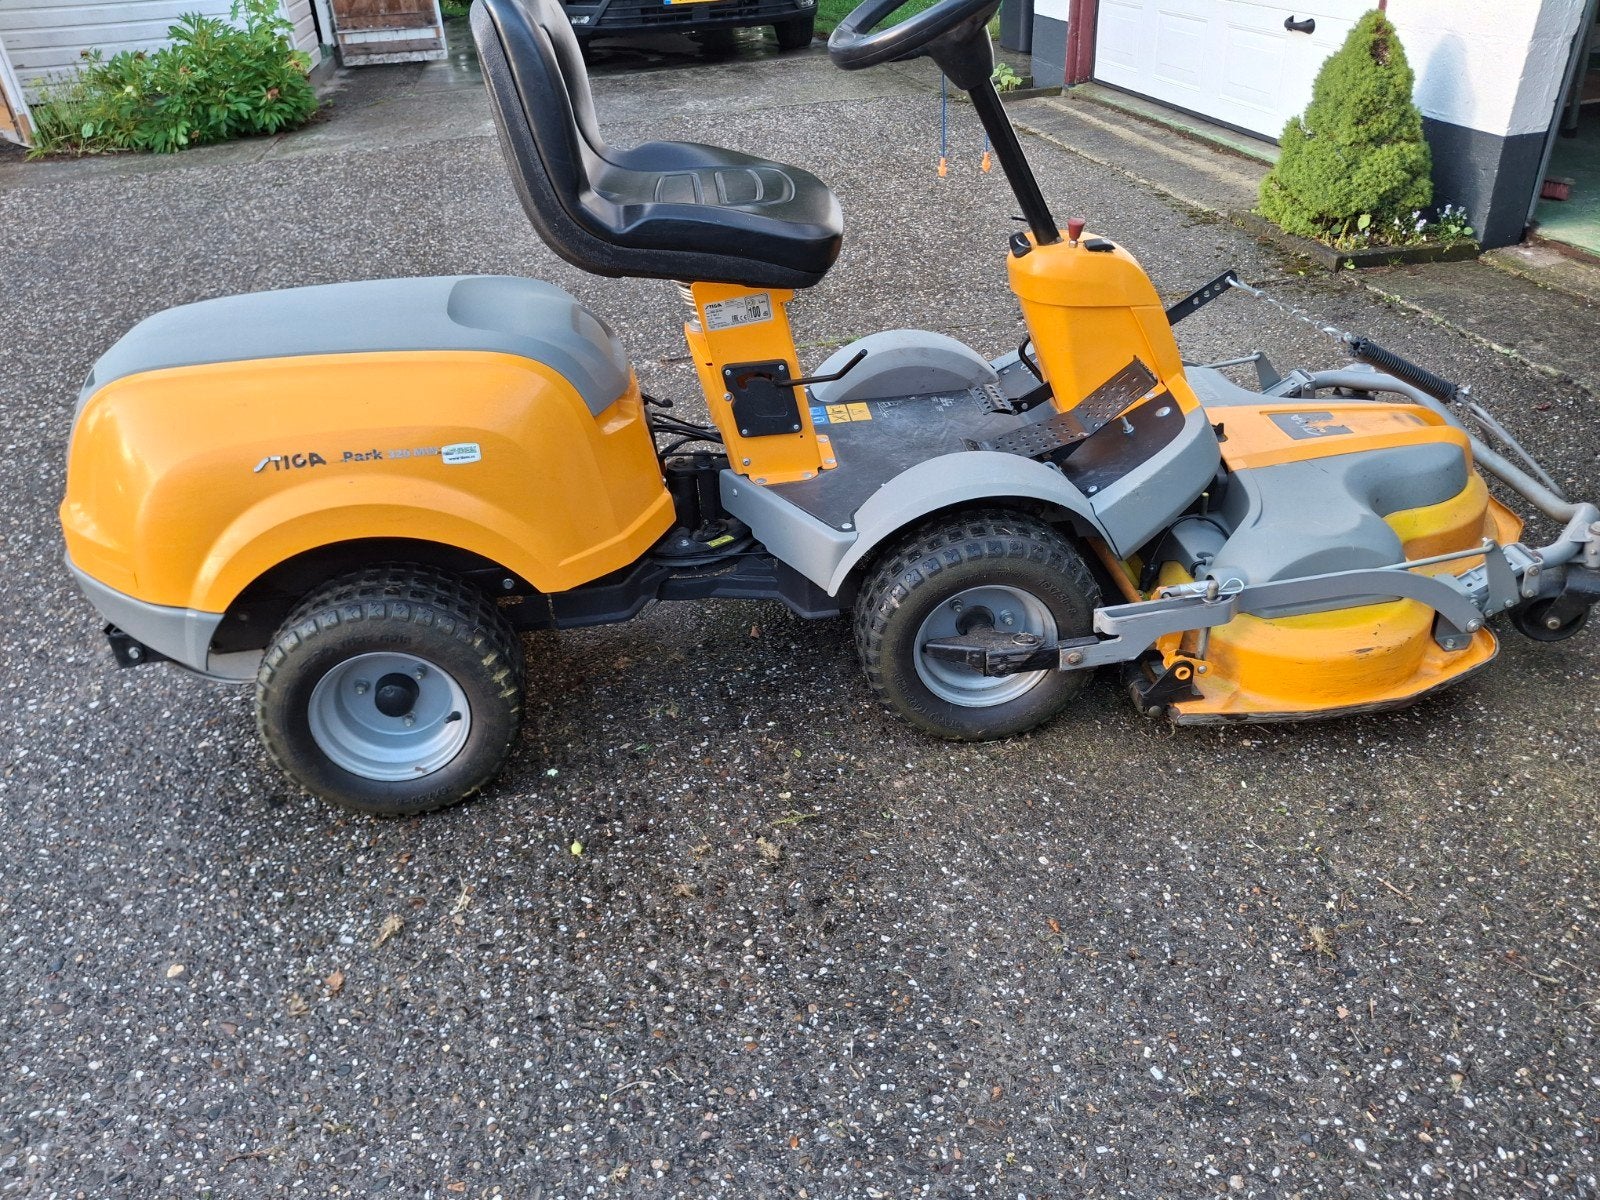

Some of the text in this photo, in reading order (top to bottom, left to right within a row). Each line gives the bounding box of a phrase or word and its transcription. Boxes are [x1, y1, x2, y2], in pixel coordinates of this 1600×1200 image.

[748, 306, 761, 318] 100
[253, 452, 327, 473] STIGA
[342, 449, 383, 462] Park
